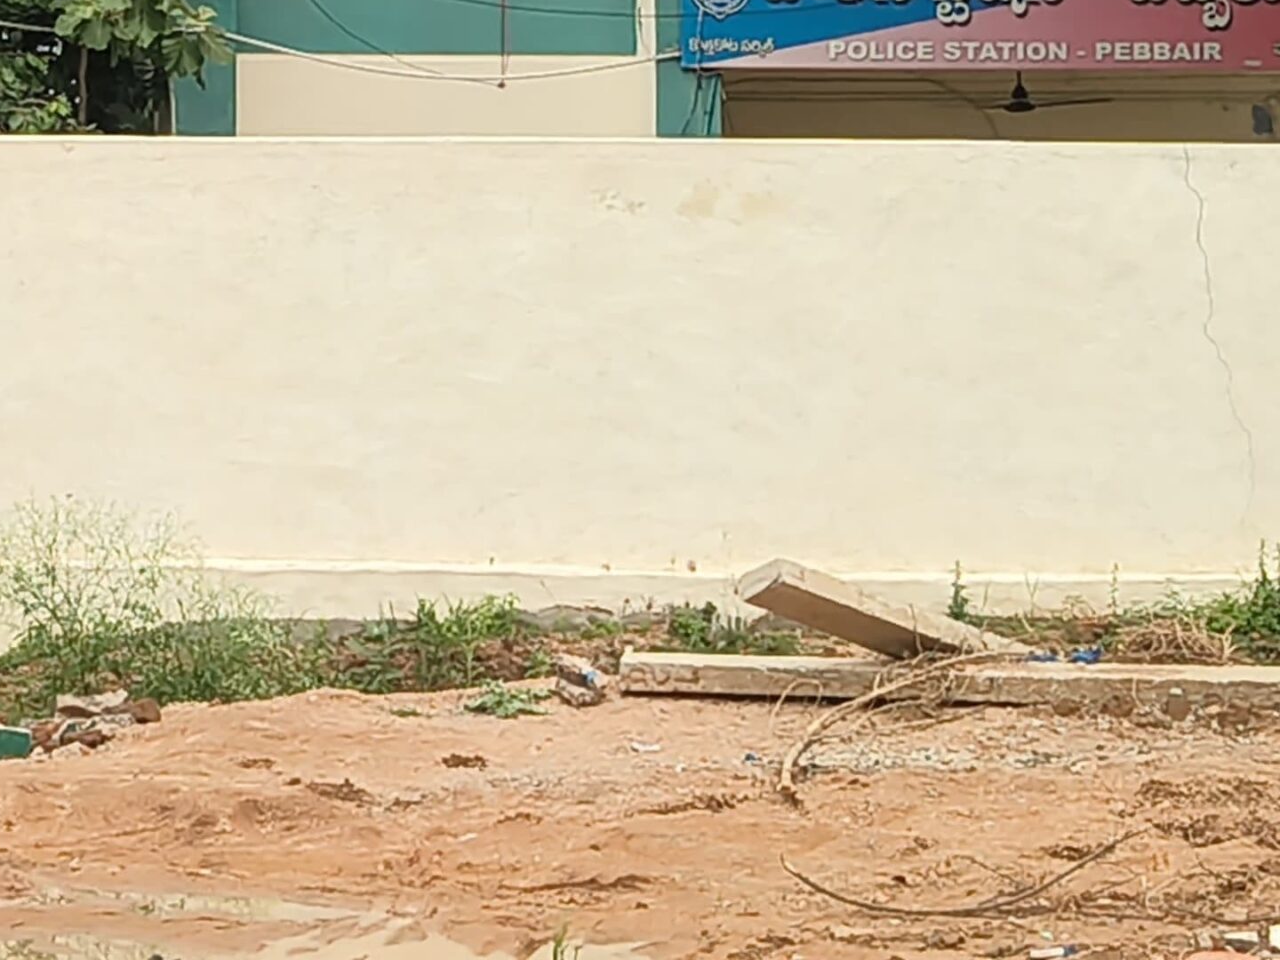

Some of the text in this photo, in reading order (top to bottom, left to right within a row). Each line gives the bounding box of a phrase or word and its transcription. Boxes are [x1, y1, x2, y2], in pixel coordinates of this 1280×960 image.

[827, 40, 934, 61] POLICE
[943, 40, 1067, 61] STATION
[1095, 41, 1222, 61] PEBBAIR
